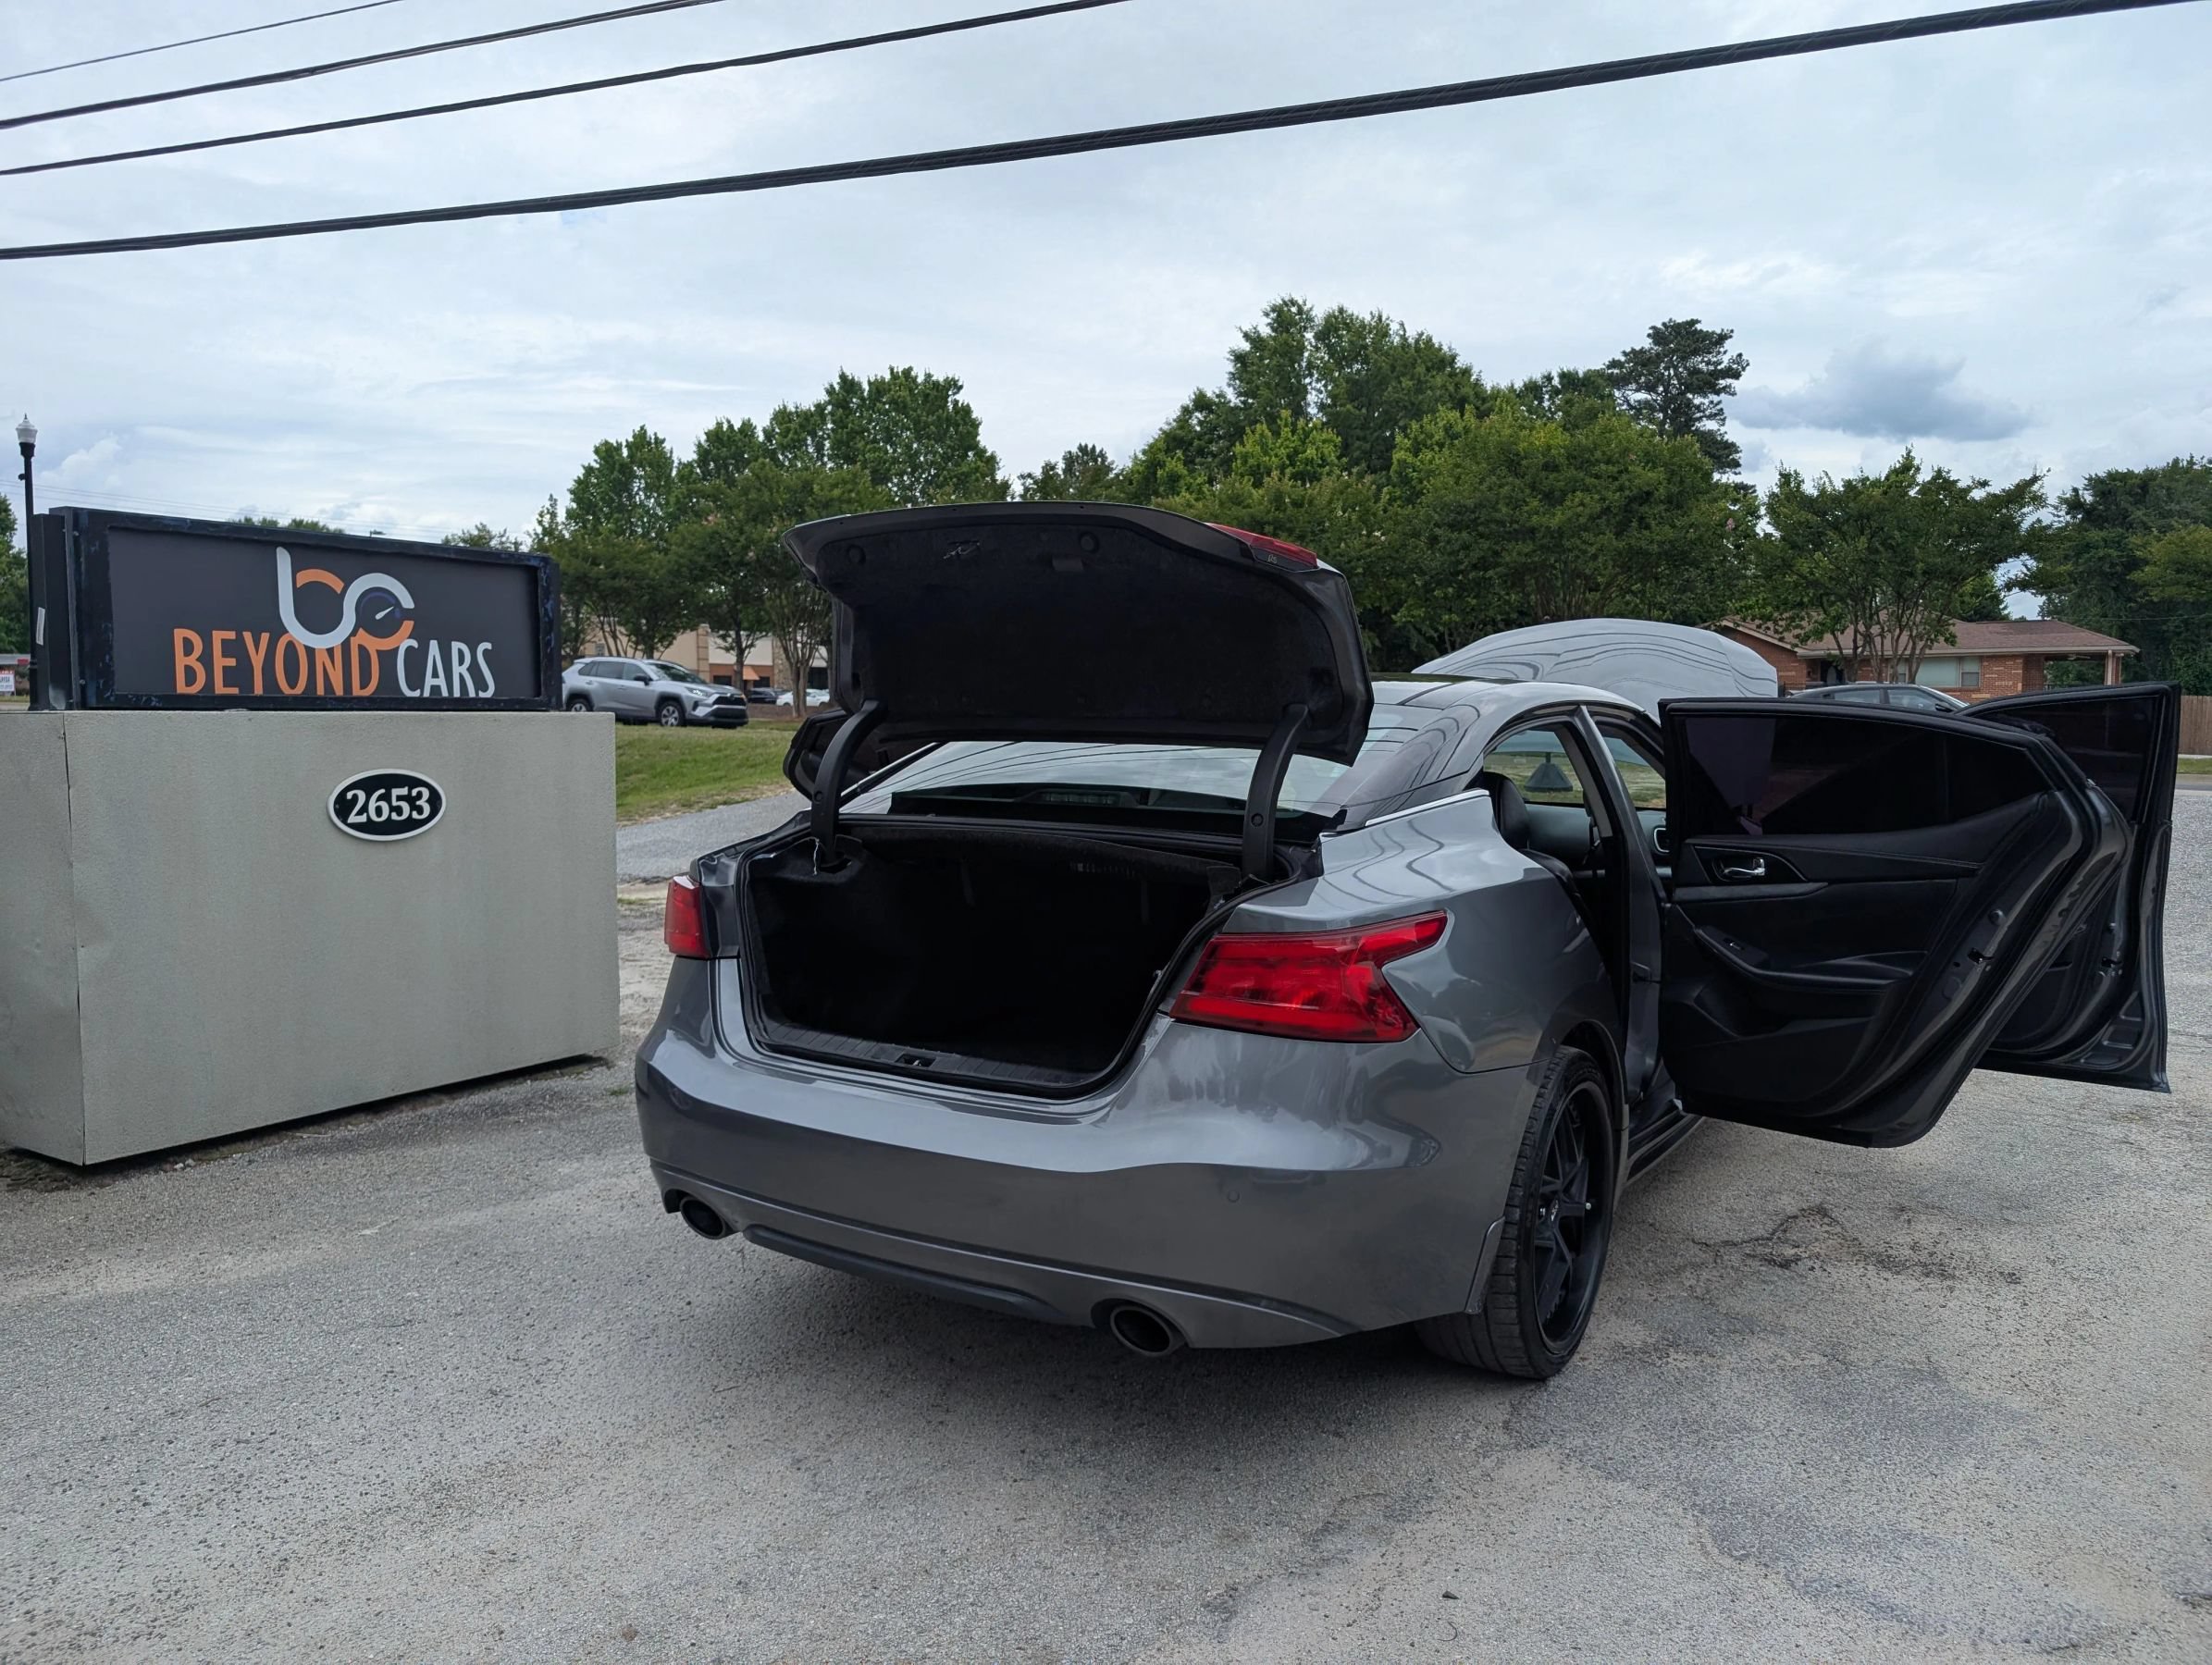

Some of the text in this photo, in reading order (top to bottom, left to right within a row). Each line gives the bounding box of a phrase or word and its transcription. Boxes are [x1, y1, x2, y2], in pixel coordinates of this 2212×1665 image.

[173, 628, 496, 697] BEYOND CARS
[346, 786, 431, 823] 2653
